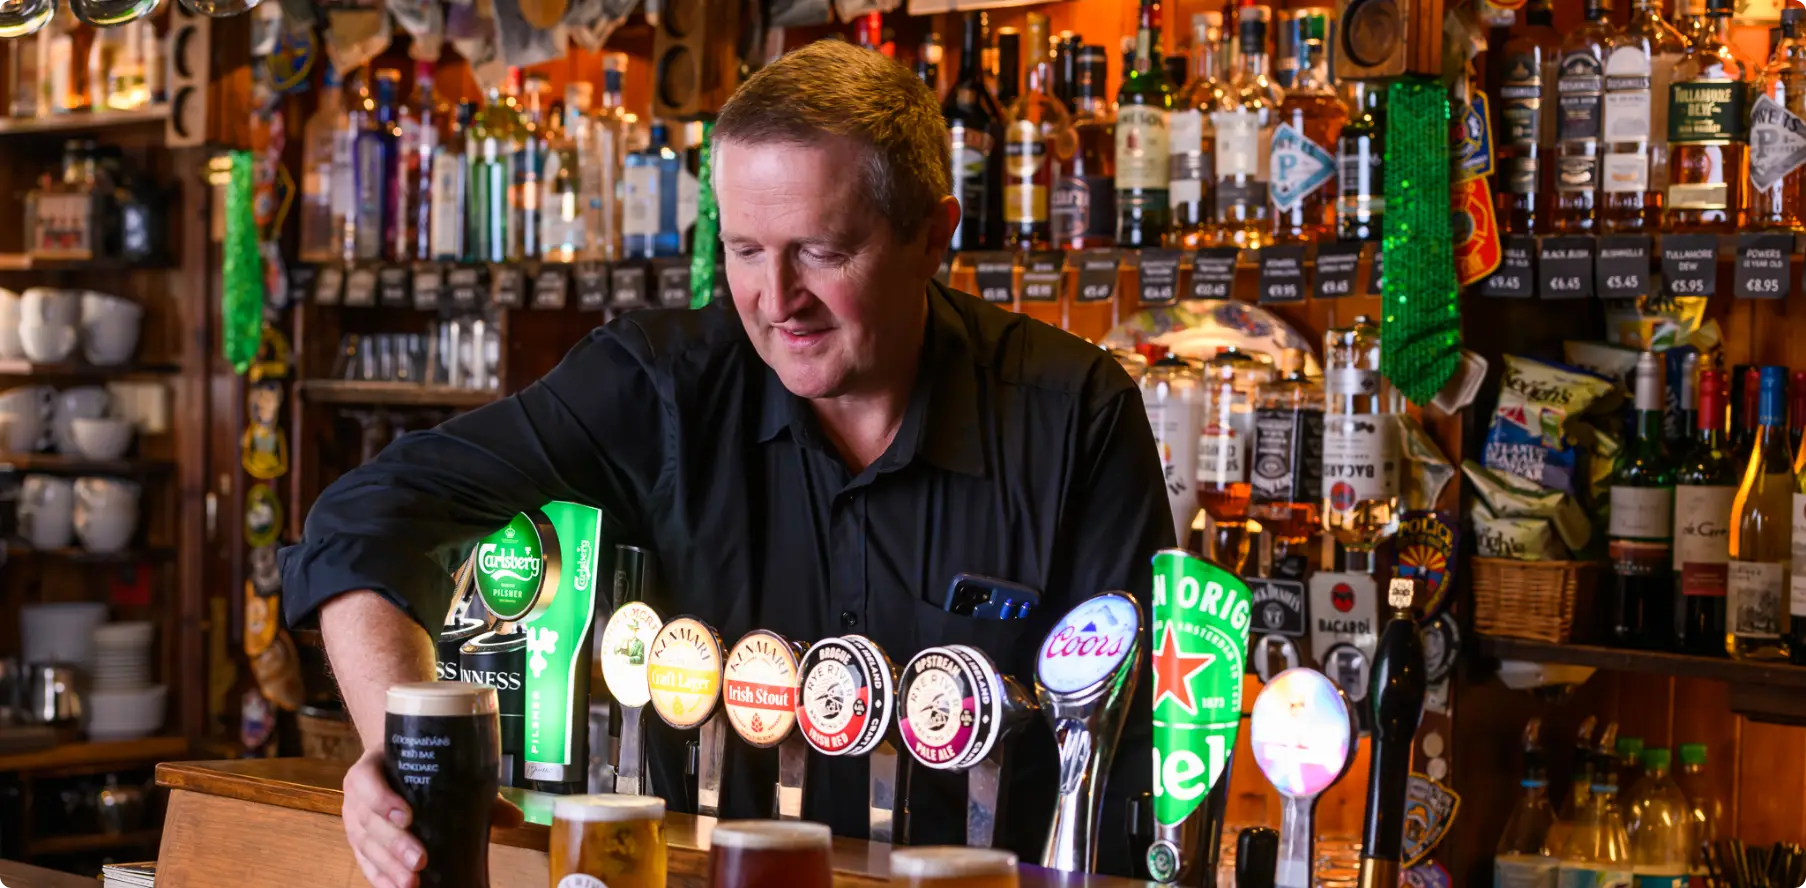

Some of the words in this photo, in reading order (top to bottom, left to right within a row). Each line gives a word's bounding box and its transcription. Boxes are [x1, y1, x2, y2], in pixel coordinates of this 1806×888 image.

[1558, 78, 1602, 92] BUSHMILLS
[1607, 78, 1650, 91] BUSHMILLS
[1675, 86, 1733, 102] TULLAMORE
[1756, 129, 1779, 159] P
[1278, 154, 1297, 180] P
[1601, 248, 1644, 258] BUSHMILLS
[1666, 249, 1713, 260] TULLAMORE
[1746, 248, 1781, 259] POWERS
[1678, 261, 1698, 272] DEW
[1769, 260, 1783, 268] OLD
[1550, 277, 1581, 290] €6.45
[1607, 275, 1639, 288] €5.45
[1671, 279, 1704, 292] €5.95
[1746, 279, 1780, 293] €8.95
[478, 543, 541, 577] Carlsberg
[574, 540, 592, 591] Carlsberg
[493, 588, 523, 598] PILSNER
[1046, 625, 1125, 660] Coors
[818, 646, 852, 666] BROGUE
[914, 654, 962, 677] UPSTREAM
[807, 666, 825, 691] RYE
[860, 648, 882, 690] IRELAND
[651, 669, 676, 691] Craft
[678, 672, 710, 693] Lager
[970, 661, 991, 706] IRELAND
[728, 684, 754, 703] Irish
[755, 687, 789, 707] Stout
[531, 690, 541, 754] PILSNER
[808, 727, 831, 748] IRISH
[832, 732, 849, 748] RED
[915, 741, 937, 761] PALE
[938, 744, 956, 761] ALE
[403, 775, 431, 785] STOUT
